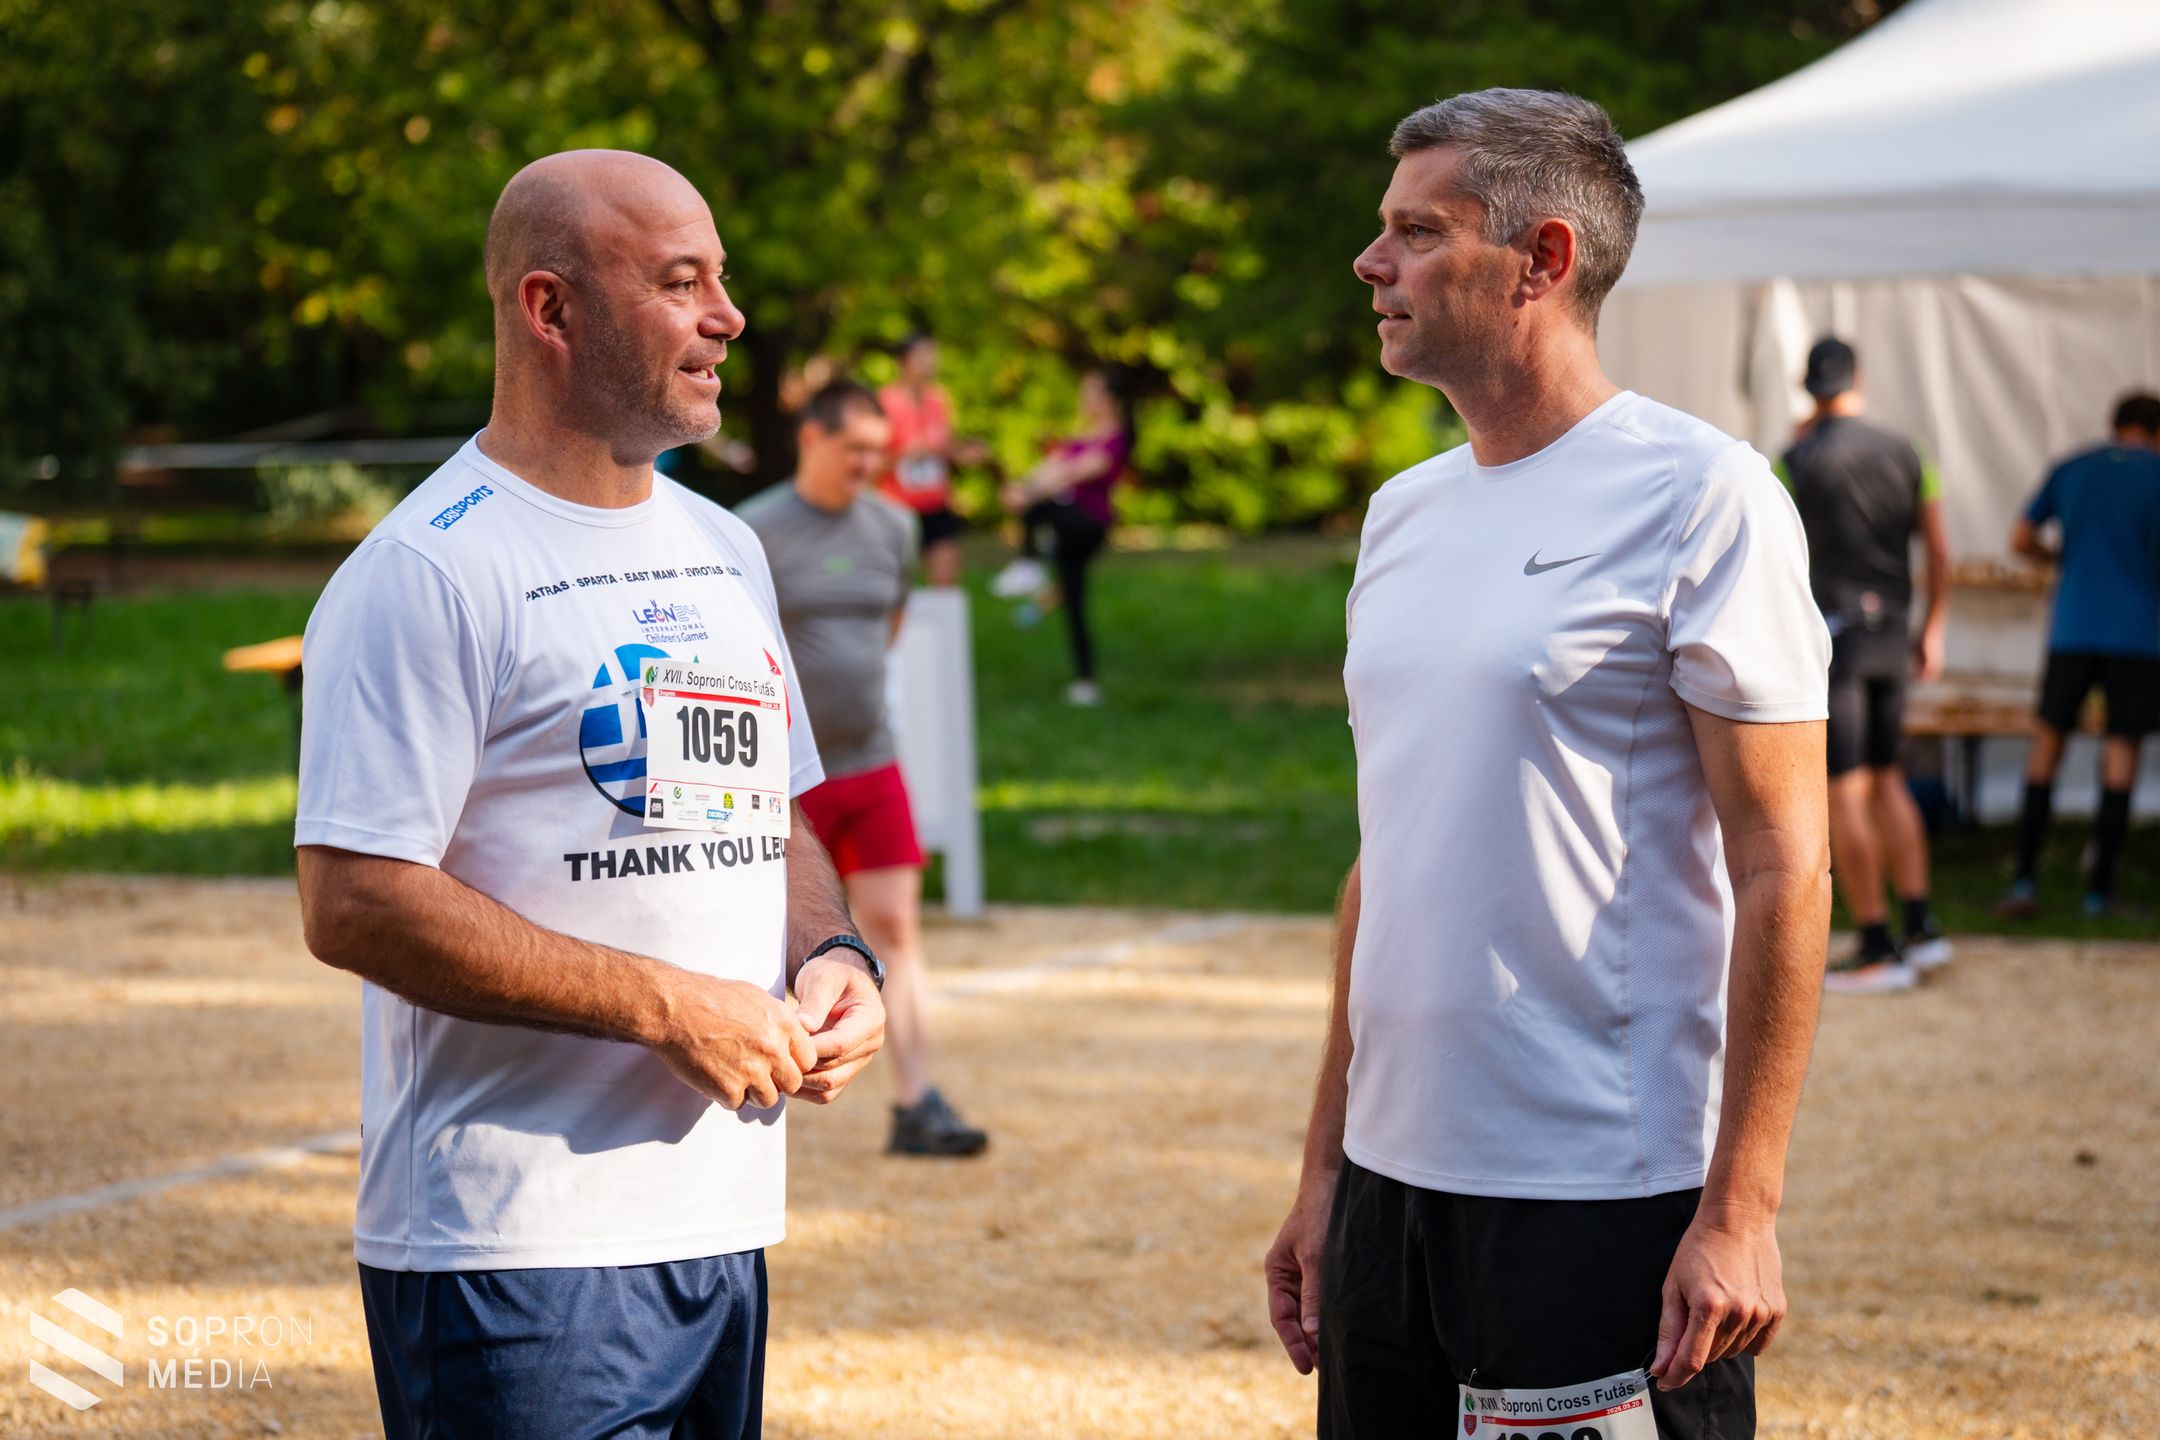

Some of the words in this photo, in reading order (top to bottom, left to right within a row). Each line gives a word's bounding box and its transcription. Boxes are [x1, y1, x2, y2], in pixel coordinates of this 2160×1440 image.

[526, 580, 570, 602] PATRAS
[576, 574, 618, 588] SPARTA
[624, 571, 650, 583] EAST
[651, 568, 678, 581] MANI
[684, 565, 724, 577] EVROTAS
[641, 623, 704, 633] INTERNATIONAL
[645, 632, 681, 644] Children's
[681, 631, 709, 642] Games
[662, 669, 683, 685] XVII.
[687, 671, 725, 690] Soproni
[728, 675, 753, 694] Cross
[754, 681, 776, 698] Futás
[676, 705, 759, 768] 1059
[563, 843, 696, 882] THANK
[701, 836, 754, 870] YOU
[1478, 1396, 1501, 1411] XVII.
[1502, 1397, 1544, 1416] Soproni
[1546, 1394, 1591, 1412] Cross
[1594, 1382, 1635, 1404] Futás
